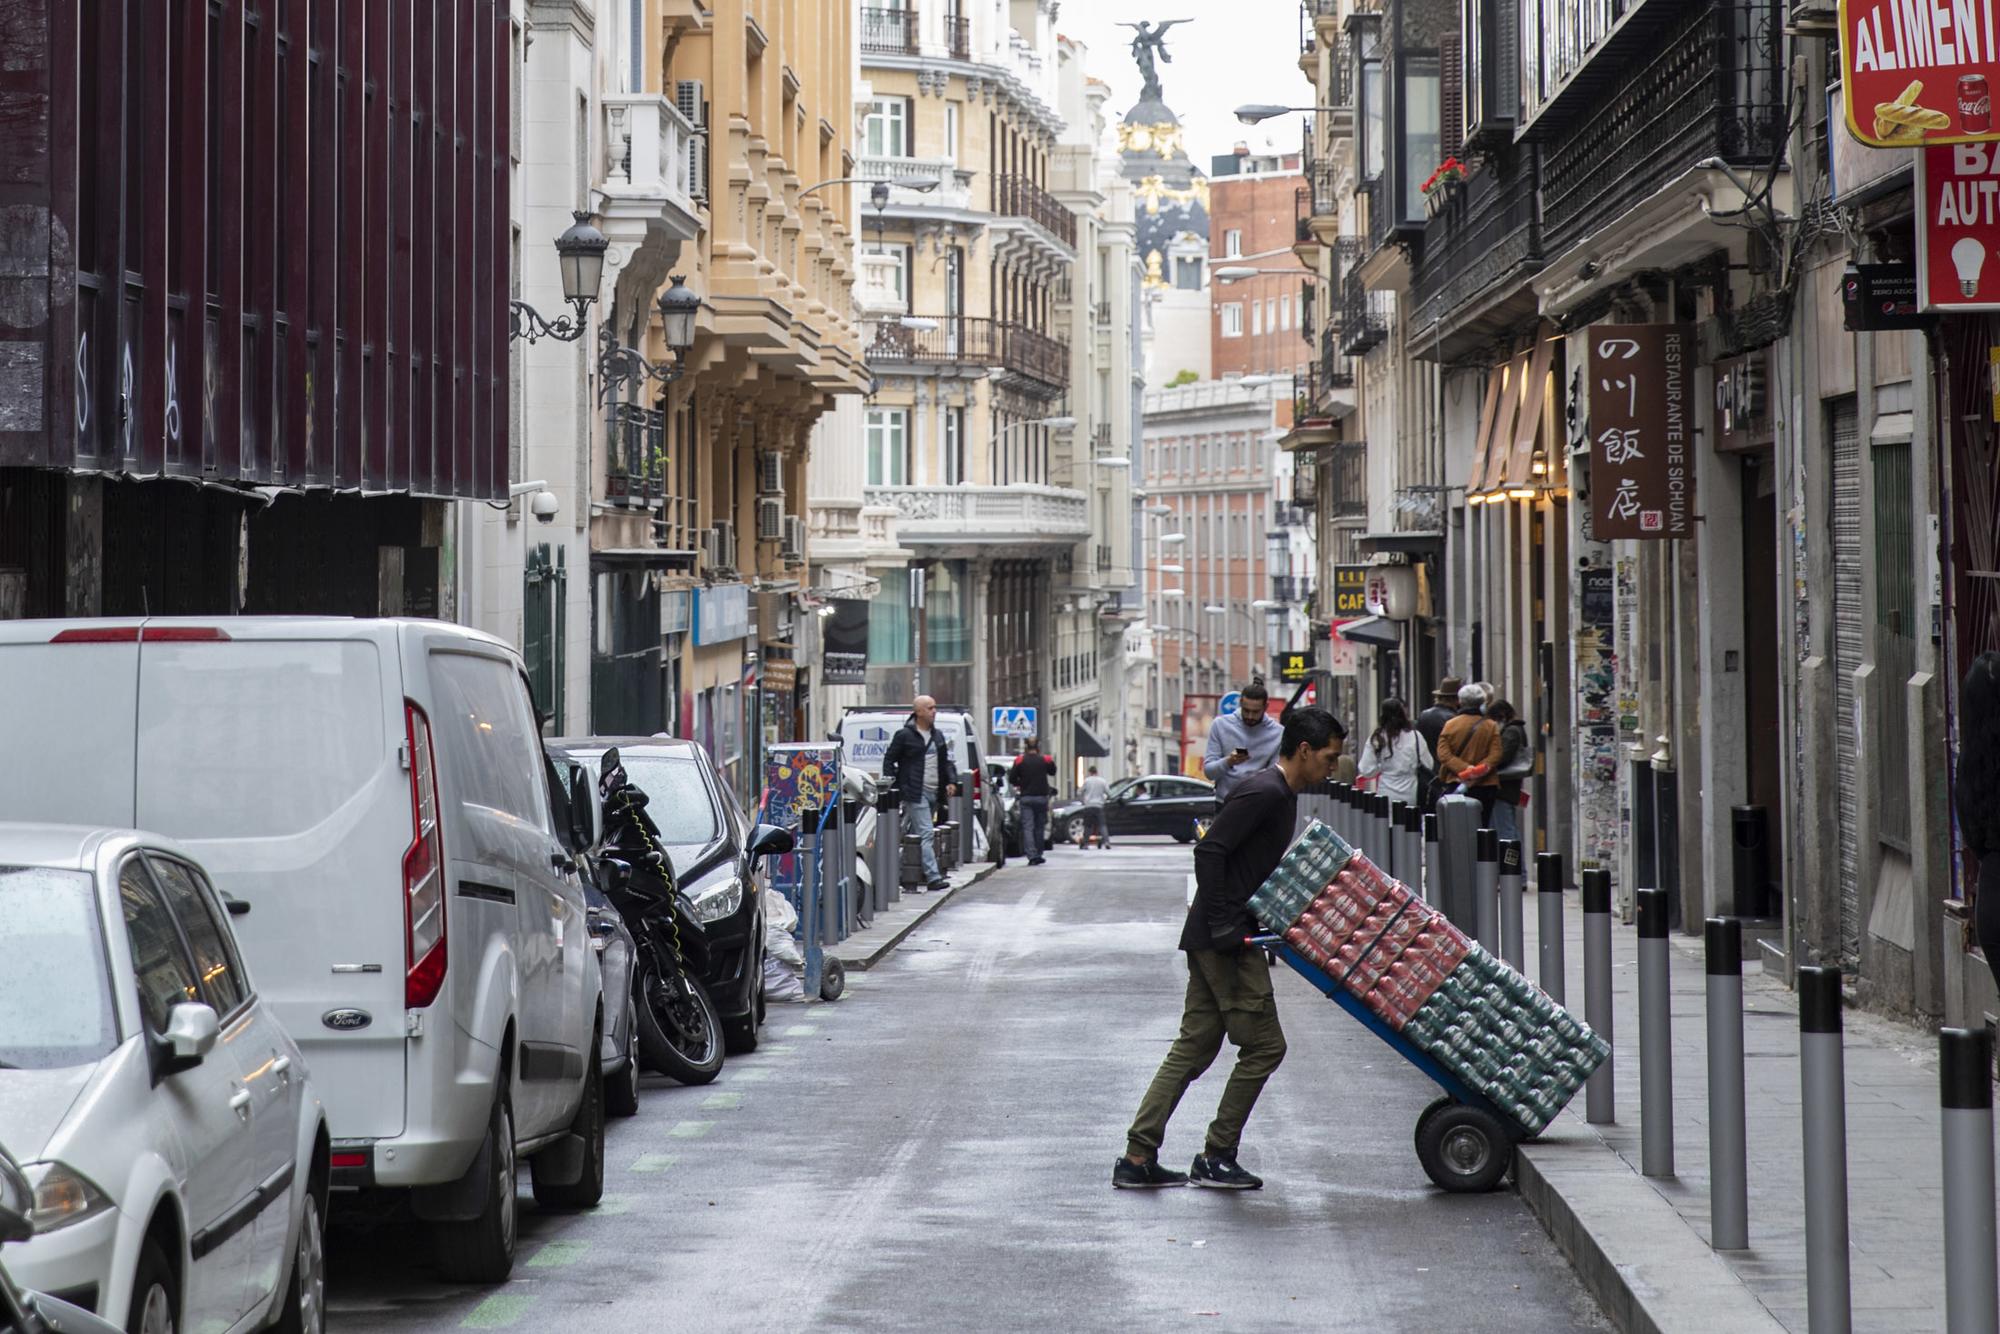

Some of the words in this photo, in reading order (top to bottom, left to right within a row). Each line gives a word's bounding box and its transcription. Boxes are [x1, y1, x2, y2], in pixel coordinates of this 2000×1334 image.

[1855, 0, 2000, 73] ALIMENT
[1938, 181, 2000, 226] AUT
[1665, 333, 1684, 441] RESTAURANTE
[1667, 446, 1684, 465] DE
[1668, 468, 1685, 532] SICHUAN
[333, 1013, 361, 1025] Ford
